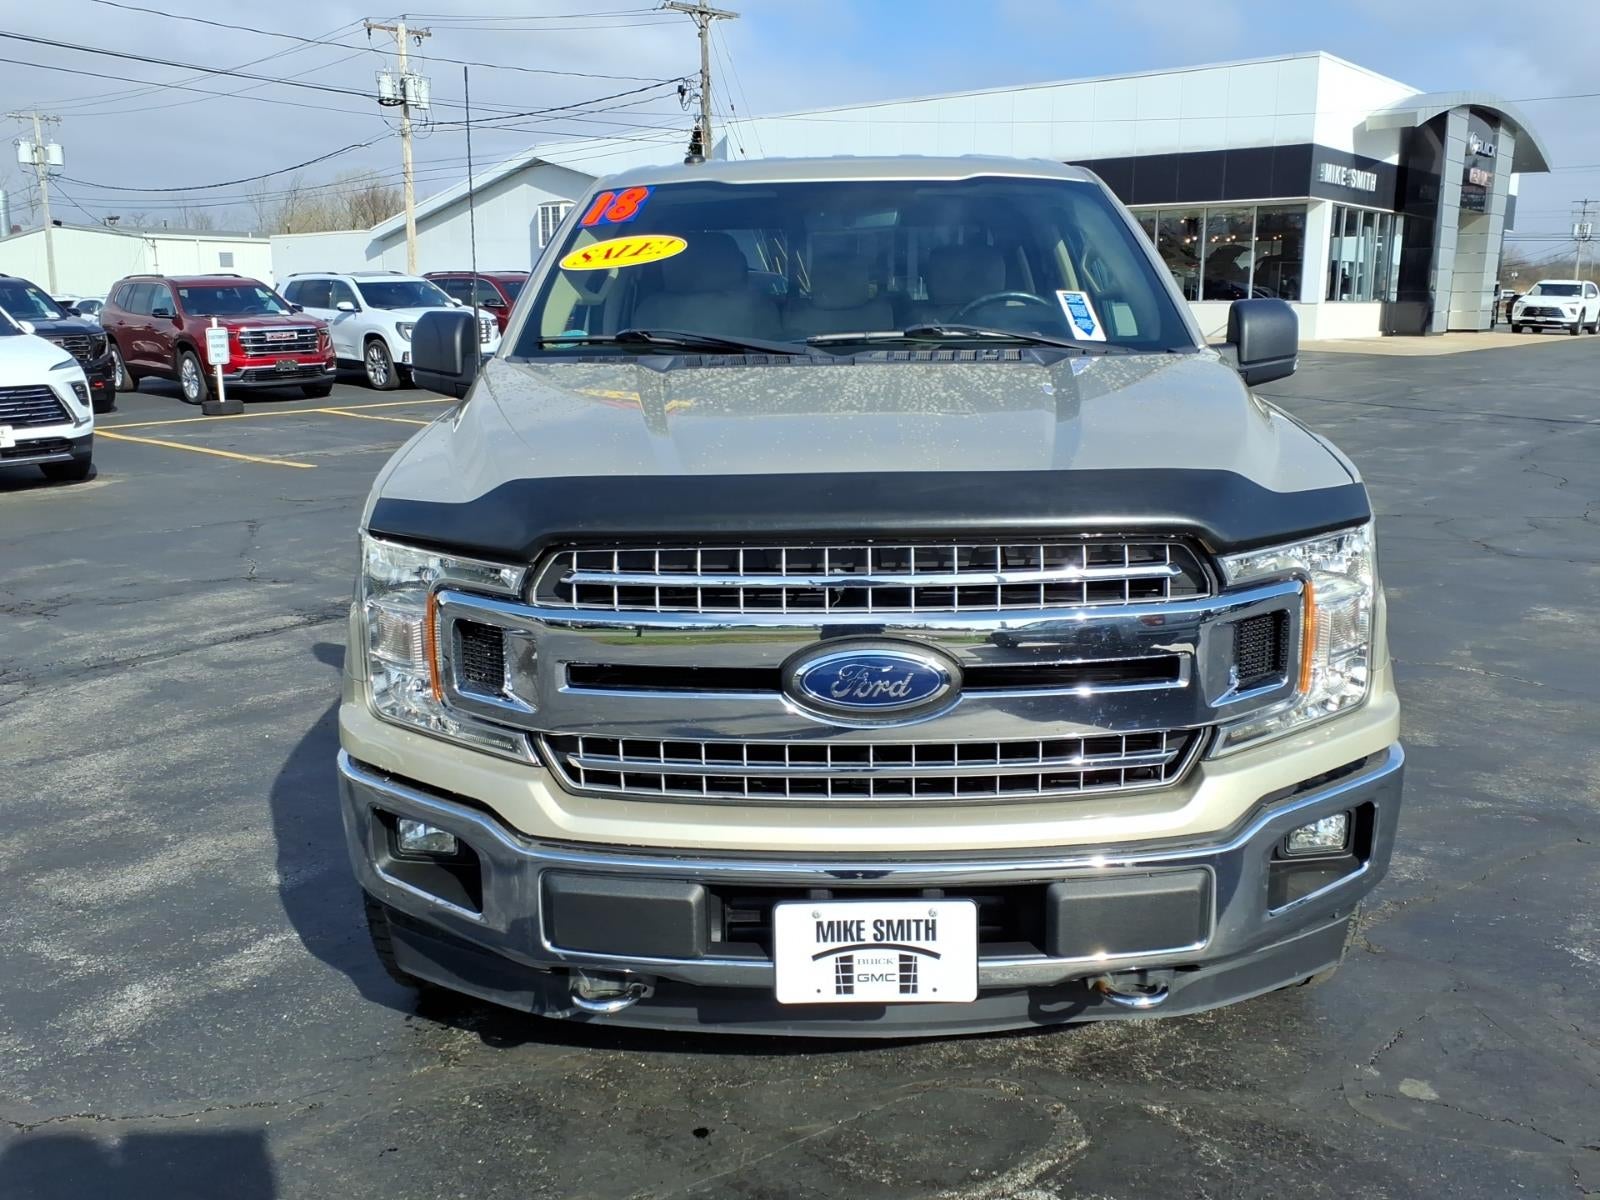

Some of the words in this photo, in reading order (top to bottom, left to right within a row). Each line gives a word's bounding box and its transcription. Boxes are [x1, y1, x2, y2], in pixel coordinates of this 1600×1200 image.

[1323, 163, 1347, 186] MIKE
[1350, 168, 1377, 192] SMITH
[582, 186, 649, 226] 18
[572, 240, 677, 265] SALE!
[830, 664, 913, 698] Ford
[816, 919, 866, 943] MIKE
[873, 919, 937, 942] SMITH
[857, 973, 897, 982] GMC
